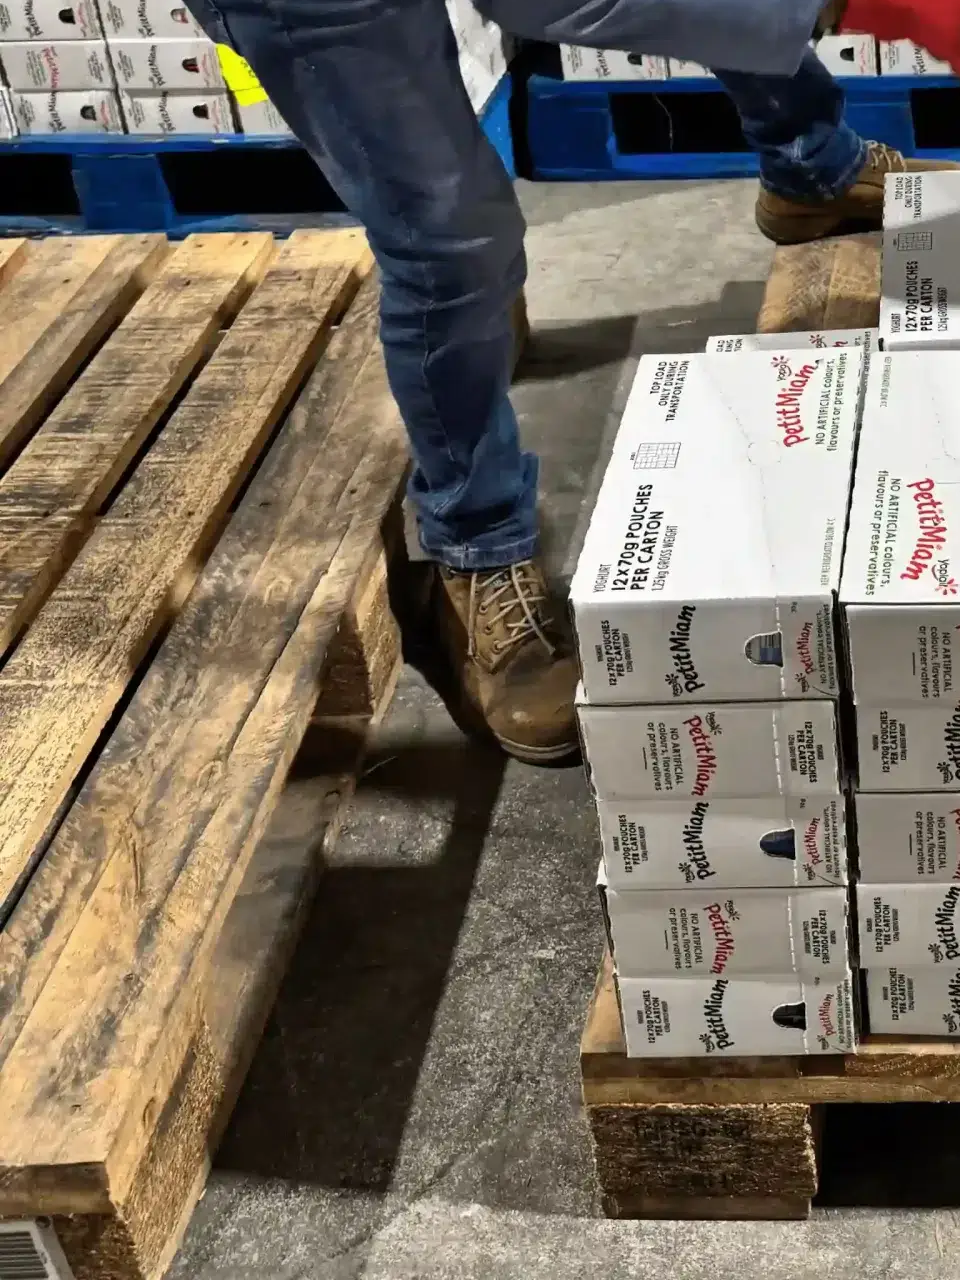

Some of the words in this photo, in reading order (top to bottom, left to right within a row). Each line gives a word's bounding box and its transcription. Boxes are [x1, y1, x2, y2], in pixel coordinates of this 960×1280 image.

[906, 260, 918, 297] POUCHES
[921, 278, 933, 317] CARTON
[921, 319, 933, 332] PER
[654, 362, 667, 379] LOAD
[664, 362, 678, 386] DURING
[823, 359, 835, 388] colours,
[833, 353, 847, 405] preservatives
[650, 382, 661, 394] TOP
[658, 388, 671, 406] ONLY
[665, 361, 690, 421] TRANSPORTATION
[817, 390, 830, 430] ARTIFICIAL
[815, 433, 825, 445] NO
[827, 417, 840, 451] flavours
[875, 470, 889, 508] flavours
[890, 478, 901, 491] NO
[625, 485, 653, 538] POUCHES
[874, 510, 883, 520] or
[885, 495, 899, 544] ARTIFICIAL
[637, 511, 664, 563] CARTON
[662, 525, 678, 548] WEIGHT
[657, 550, 672, 569] GROSS
[865, 523, 881, 596] preservatives
[880, 547, 894, 587] colours,
[593, 564, 611, 593] YOGHURT
[630, 568, 650, 590] PER
[918, 626, 927, 635] or
[941, 632, 951, 646] NO
[917, 638, 929, 698] preservatives
[931, 663, 942, 698] flavours
[942, 648, 952, 692] ARTIFICIAL
